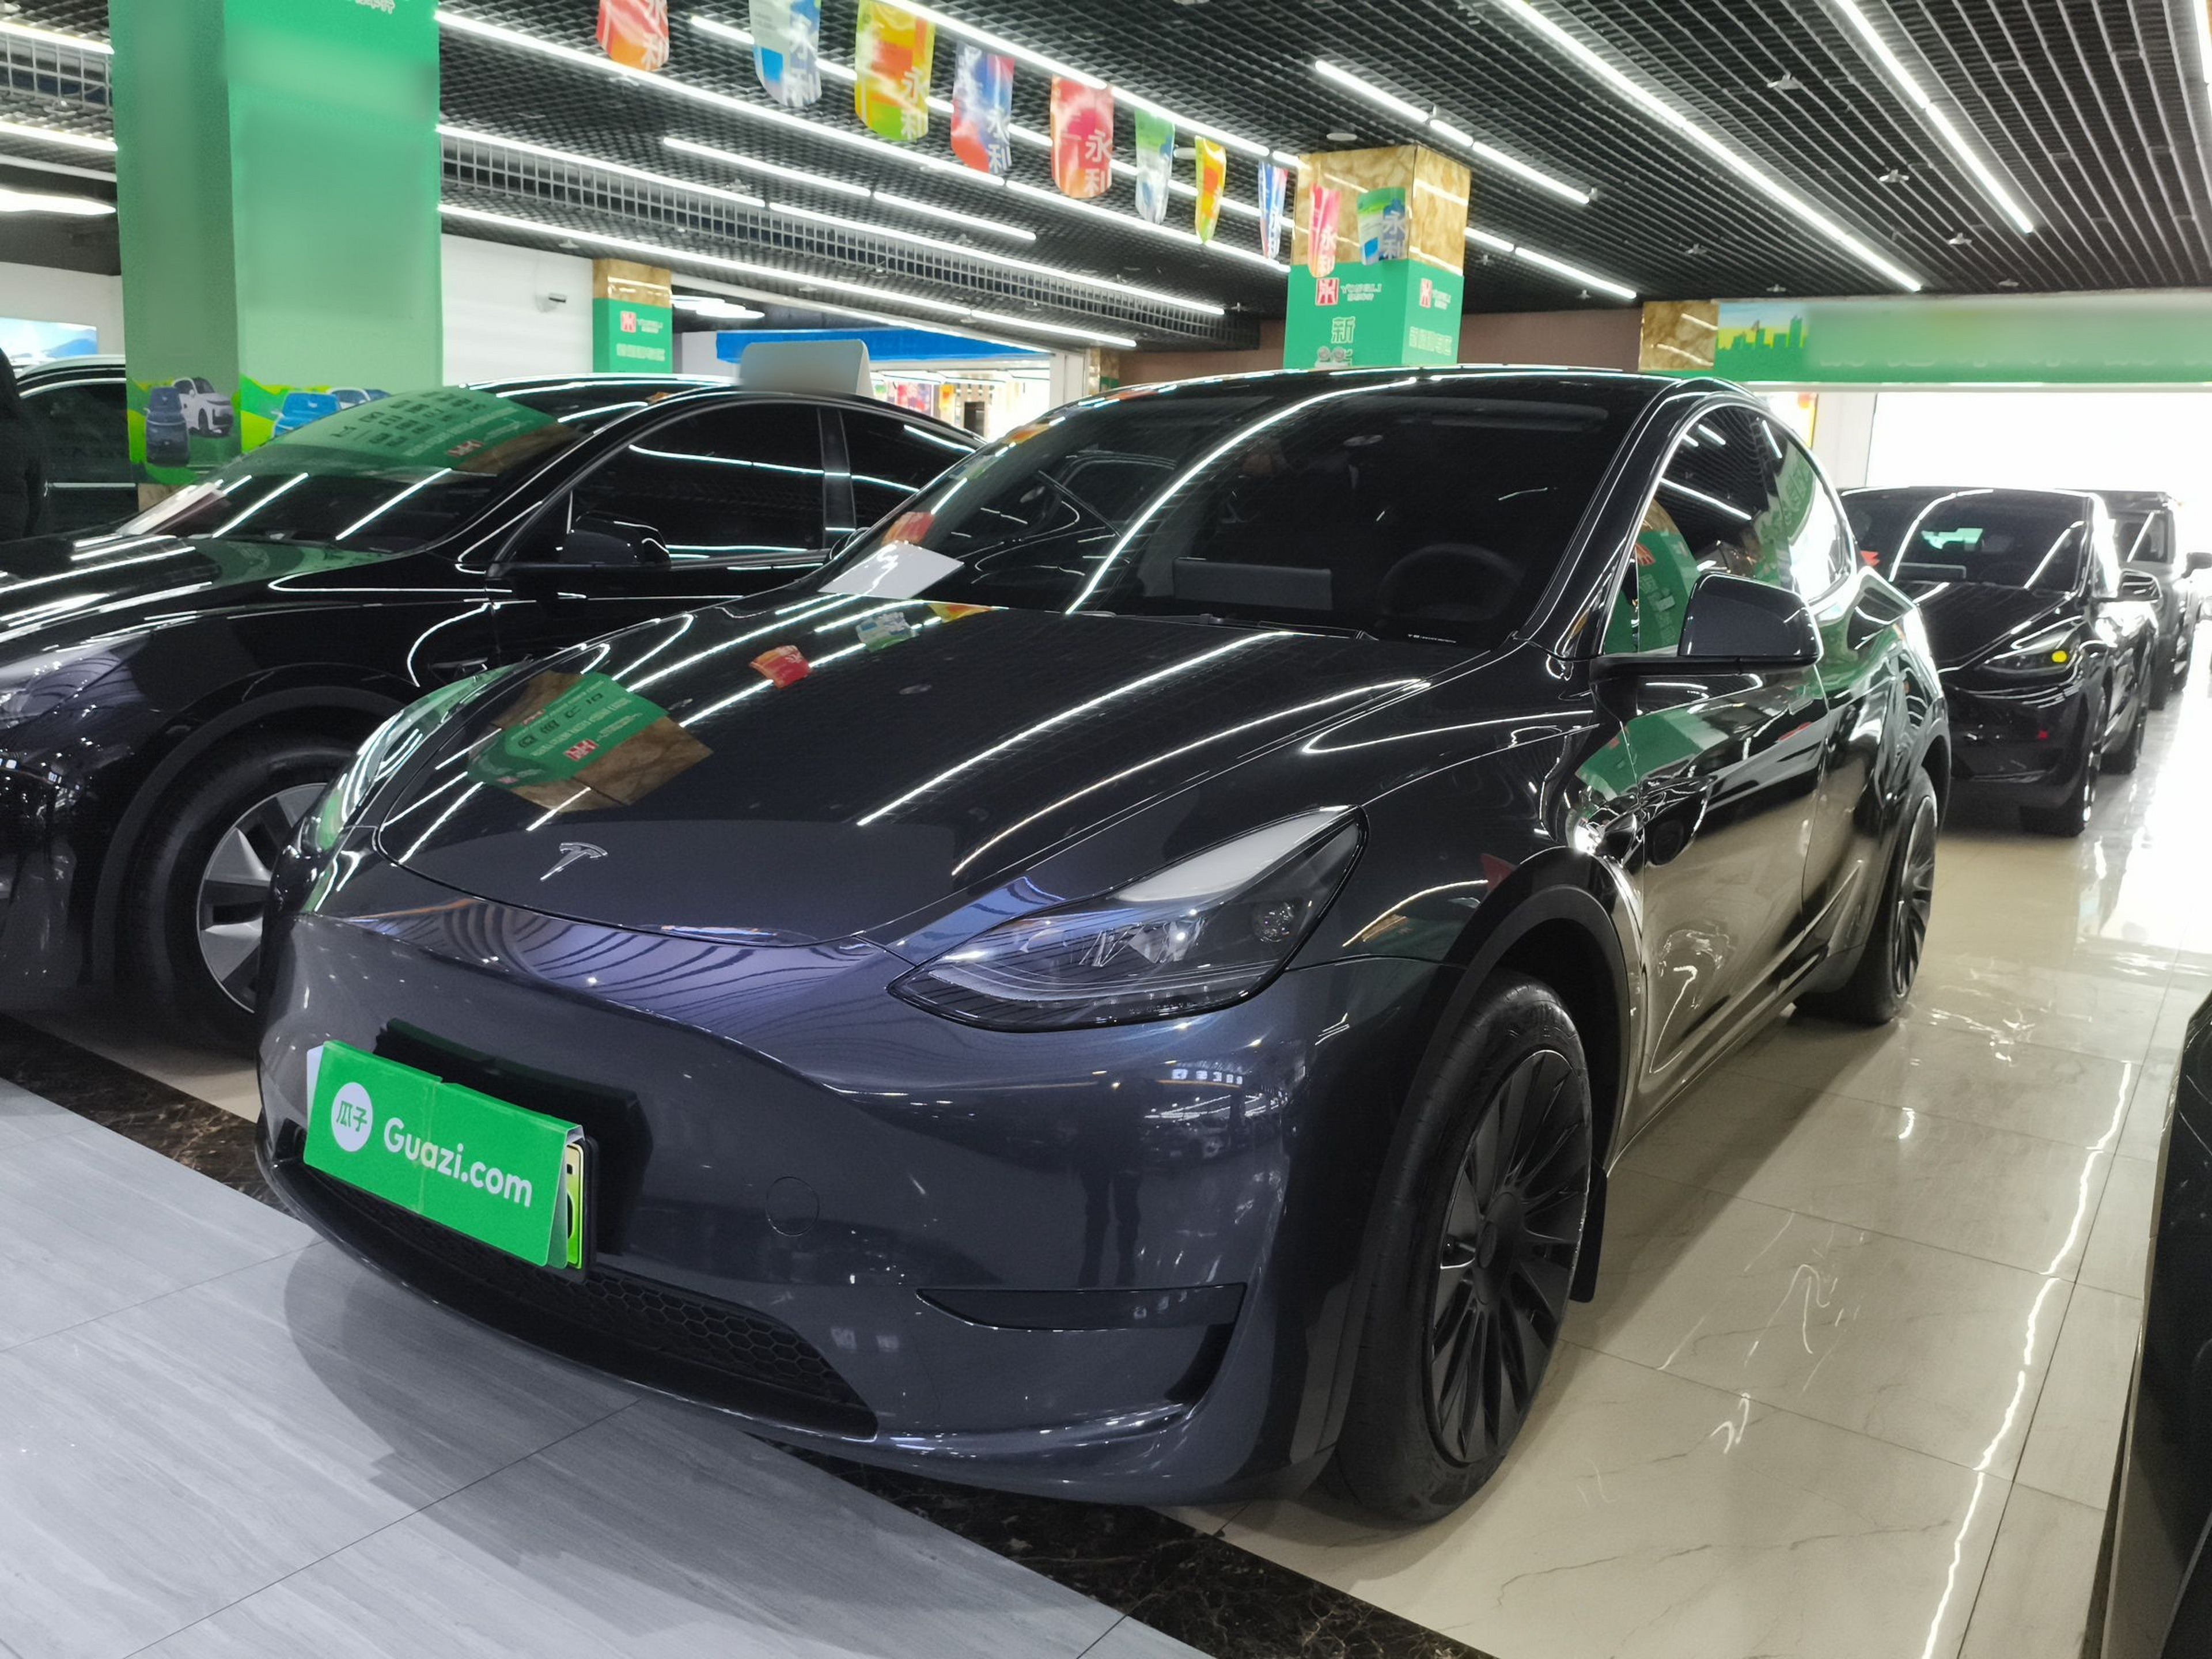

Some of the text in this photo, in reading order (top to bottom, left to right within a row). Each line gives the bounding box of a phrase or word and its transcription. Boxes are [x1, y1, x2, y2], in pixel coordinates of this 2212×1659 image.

[901, 66, 930, 141] 永利
[1085, 128, 1113, 197] 永利
[1384, 210, 1406, 260] 永利
[336, 1100, 368, 1132] 瓜子
[383, 1117, 533, 1208] Guazi.com
